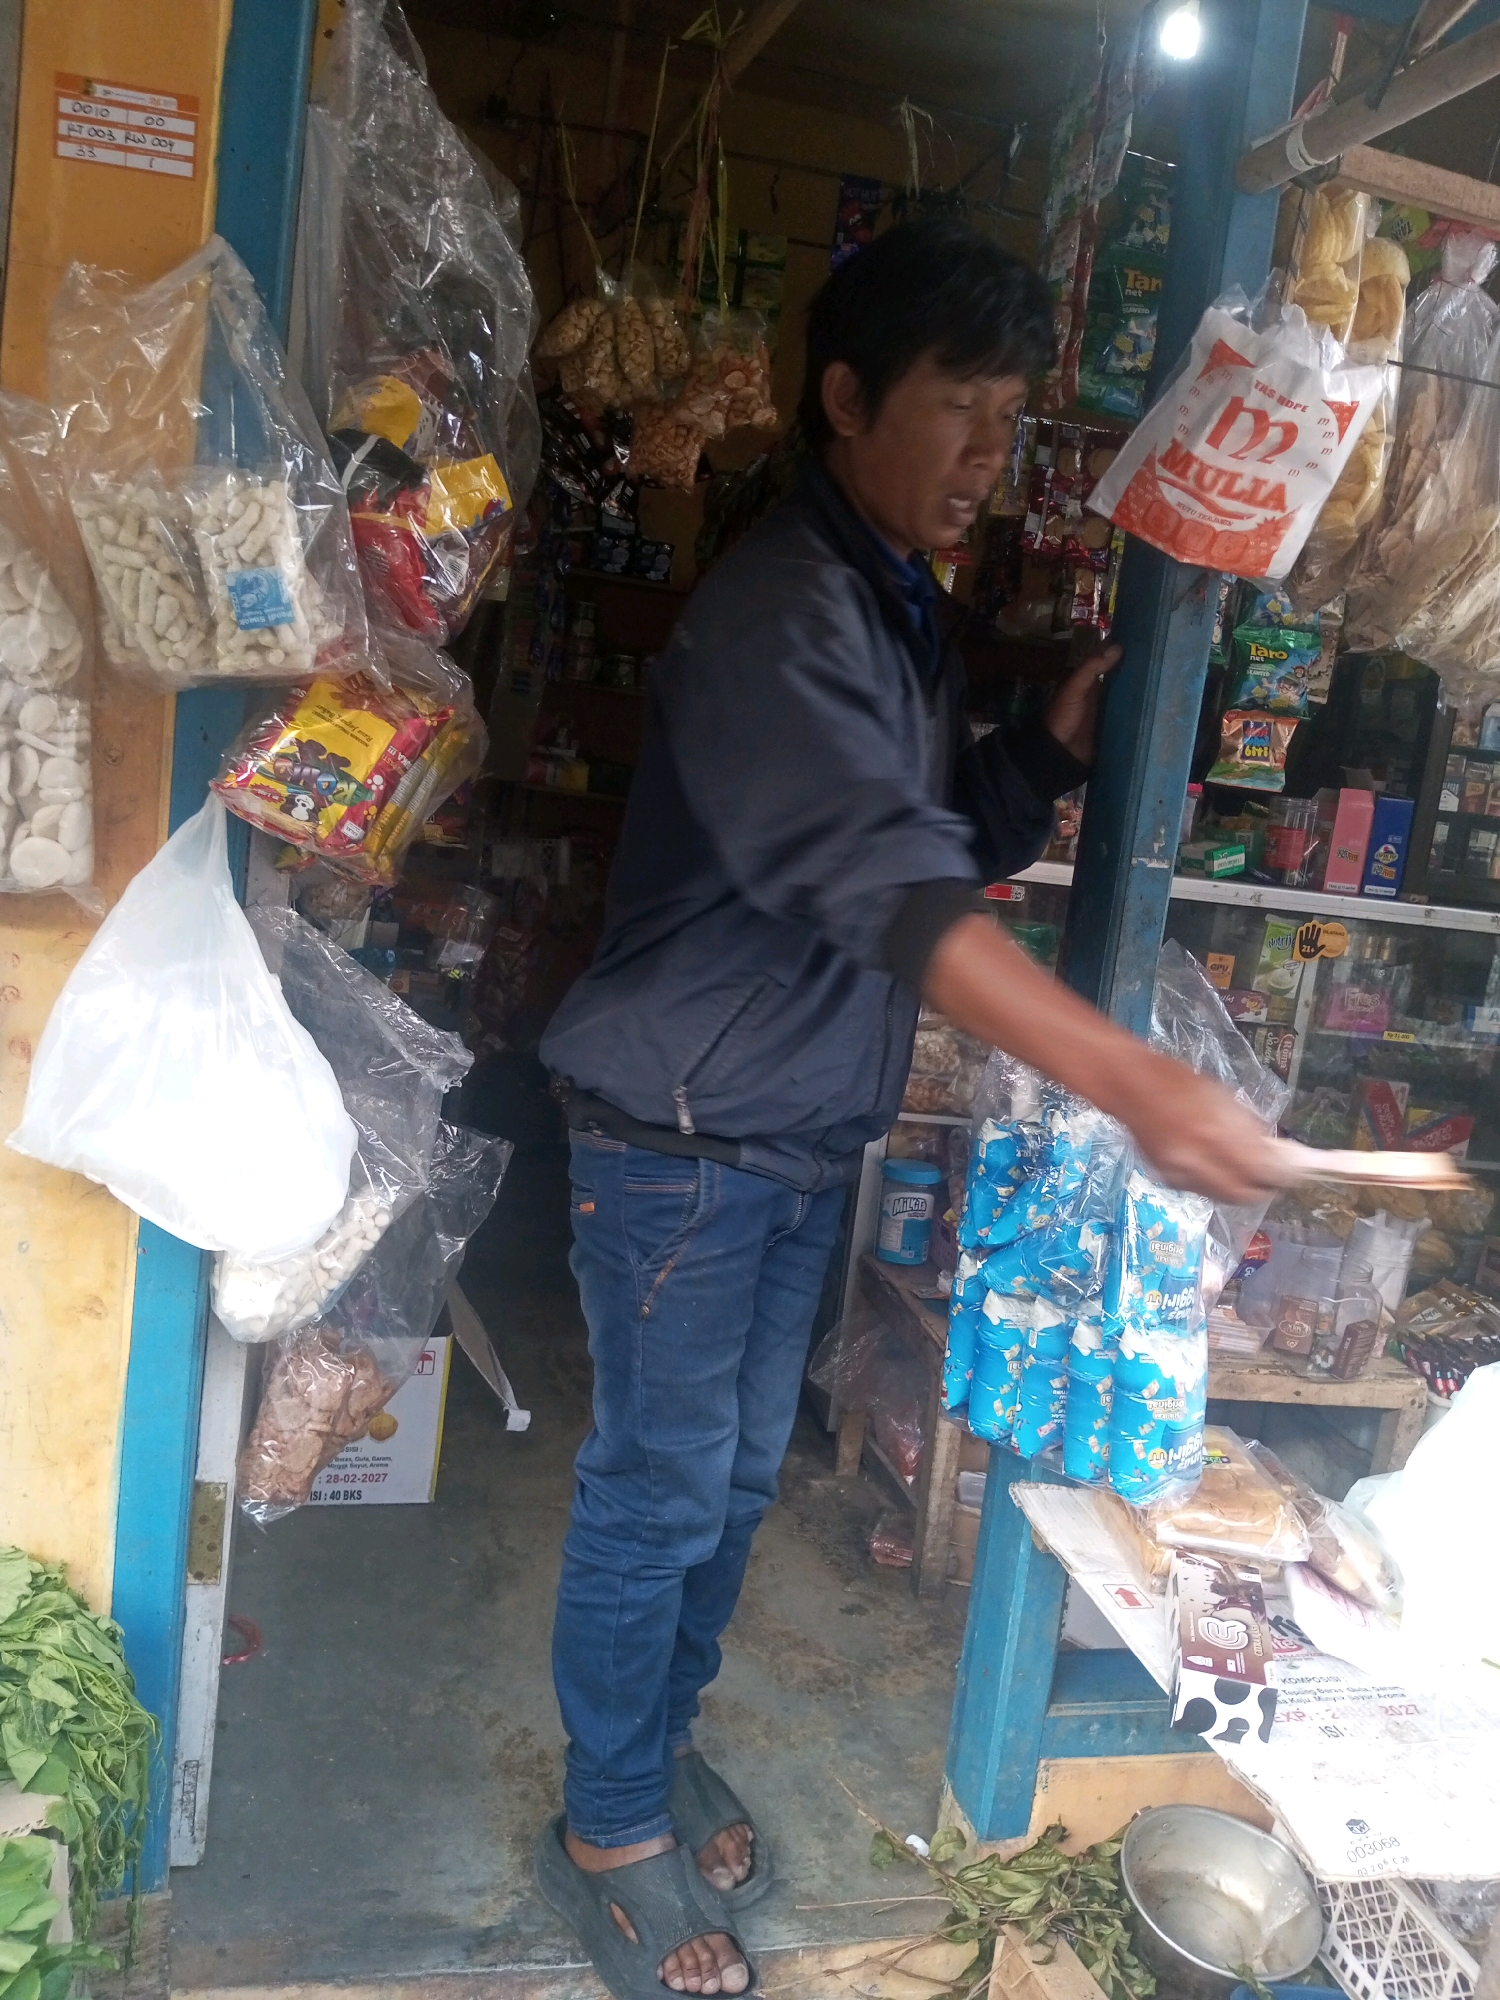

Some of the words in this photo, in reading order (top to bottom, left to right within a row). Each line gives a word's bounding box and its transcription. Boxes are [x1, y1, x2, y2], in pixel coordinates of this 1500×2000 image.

[71, 101, 110, 118] 0010
[143, 116, 166, 127] 00
[67, 123, 85, 138] RT
[87, 126, 117, 142] 003
[124, 133, 147, 145] RW
[1124, 268, 1163, 292] Tar
[1253, 379, 1277, 398] TAS
[1157, 437, 1289, 514] MULIA
[1246, 642, 1288, 661] Taro
[1250, 655, 1265, 663] net
[1301, 944, 1316, 953] 21+
[1209, 962, 1229, 972] GPU
[1279, 1040, 1293, 1070] Roma
[1151, 1241, 1184, 1255] original
[1161, 1286, 1195, 1311] ggiri
[1167, 1307, 1191, 1321] nas
[1148, 1400, 1185, 1409] original
[1167, 1431, 1203, 1464] ggiri
[1177, 1455, 1203, 1472] unas
[325, 1473, 388, 1484] 28-02-2027
[309, 1490, 322, 1501] ISI
[329, 1490, 341, 1501] 40
[343, 1490, 363, 1500] BKS
[1281, 1675, 1342, 1685] KOMPOSISI
[1376, 1692, 1406, 1700] Aroma
[1346, 1836, 1401, 1863] 003068
